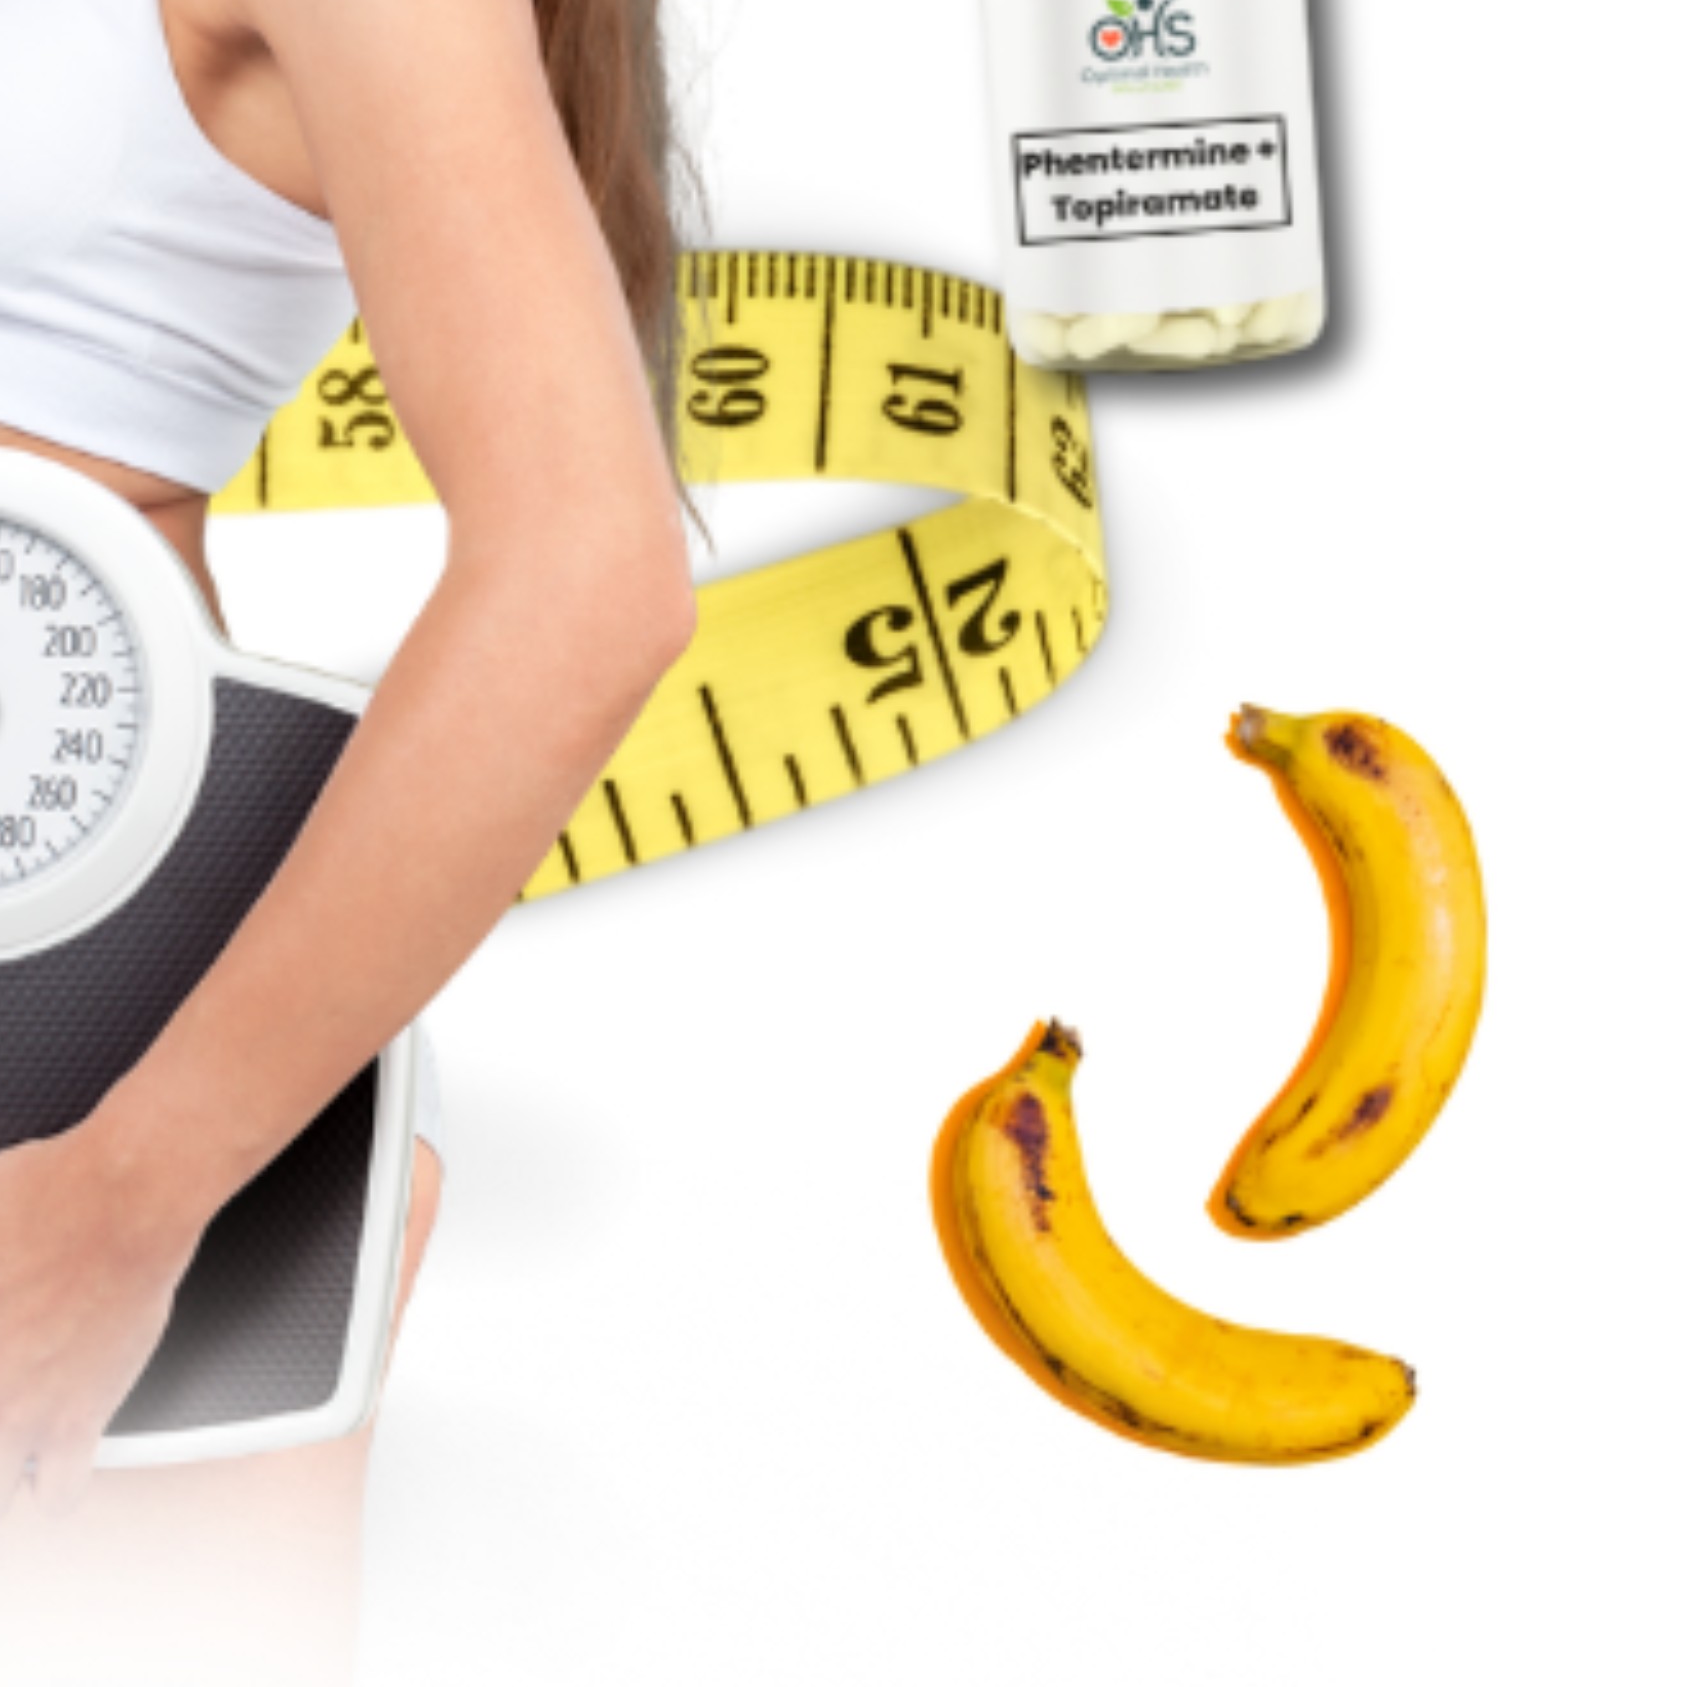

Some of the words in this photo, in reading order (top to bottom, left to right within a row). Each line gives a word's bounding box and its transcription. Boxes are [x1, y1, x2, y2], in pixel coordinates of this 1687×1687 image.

[1021, 137, 1251, 178] Phentermine
[1050, 183, 1258, 227] Topiramate
[318, 365, 395, 452] 58
[687, 346, 770, 430] 60
[882, 360, 963, 437] 61
[19, 573, 67, 610] 180
[43, 625, 96, 658] 200
[59, 673, 112, 708] 220
[53, 729, 103, 763] 240
[28, 775, 78, 810] 260
